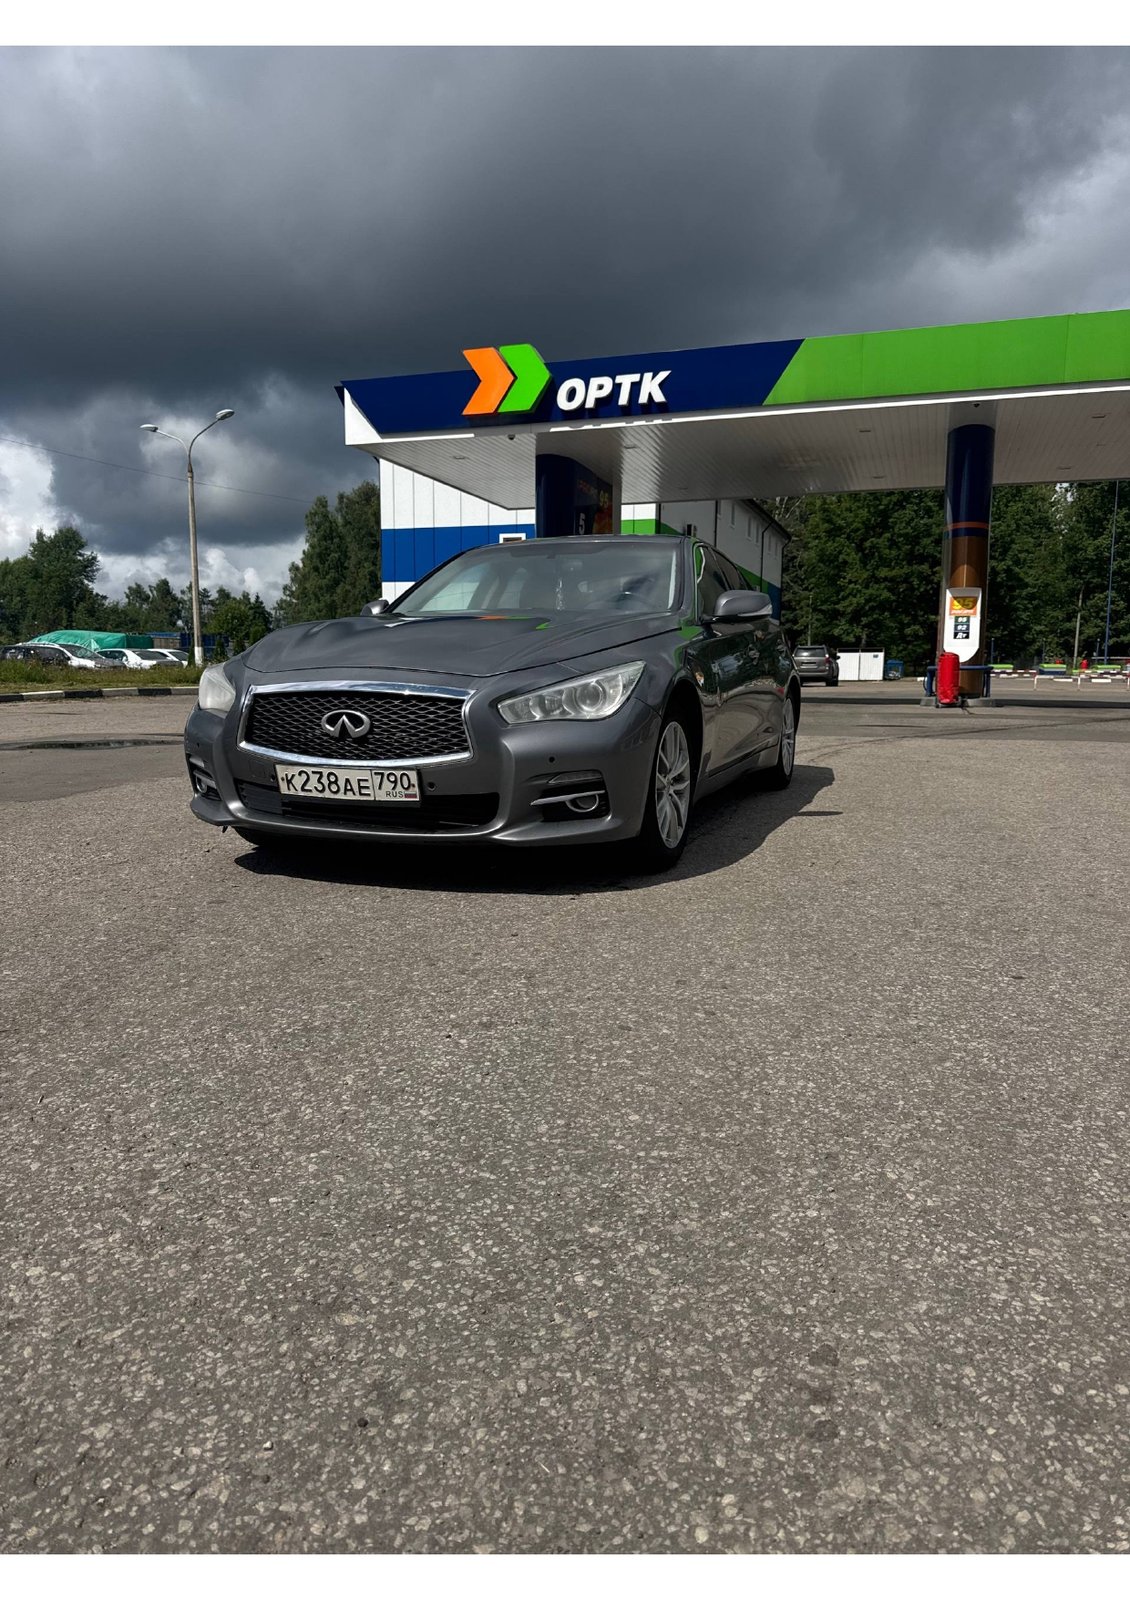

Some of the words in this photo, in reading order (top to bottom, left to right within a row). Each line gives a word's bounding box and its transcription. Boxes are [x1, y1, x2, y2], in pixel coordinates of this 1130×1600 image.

[556, 370, 672, 411] ОРТК
[953, 597, 974, 610] 95
[285, 770, 371, 797] К238АЕ
[374, 771, 411, 791] 790
[386, 790, 404, 798] RUS
